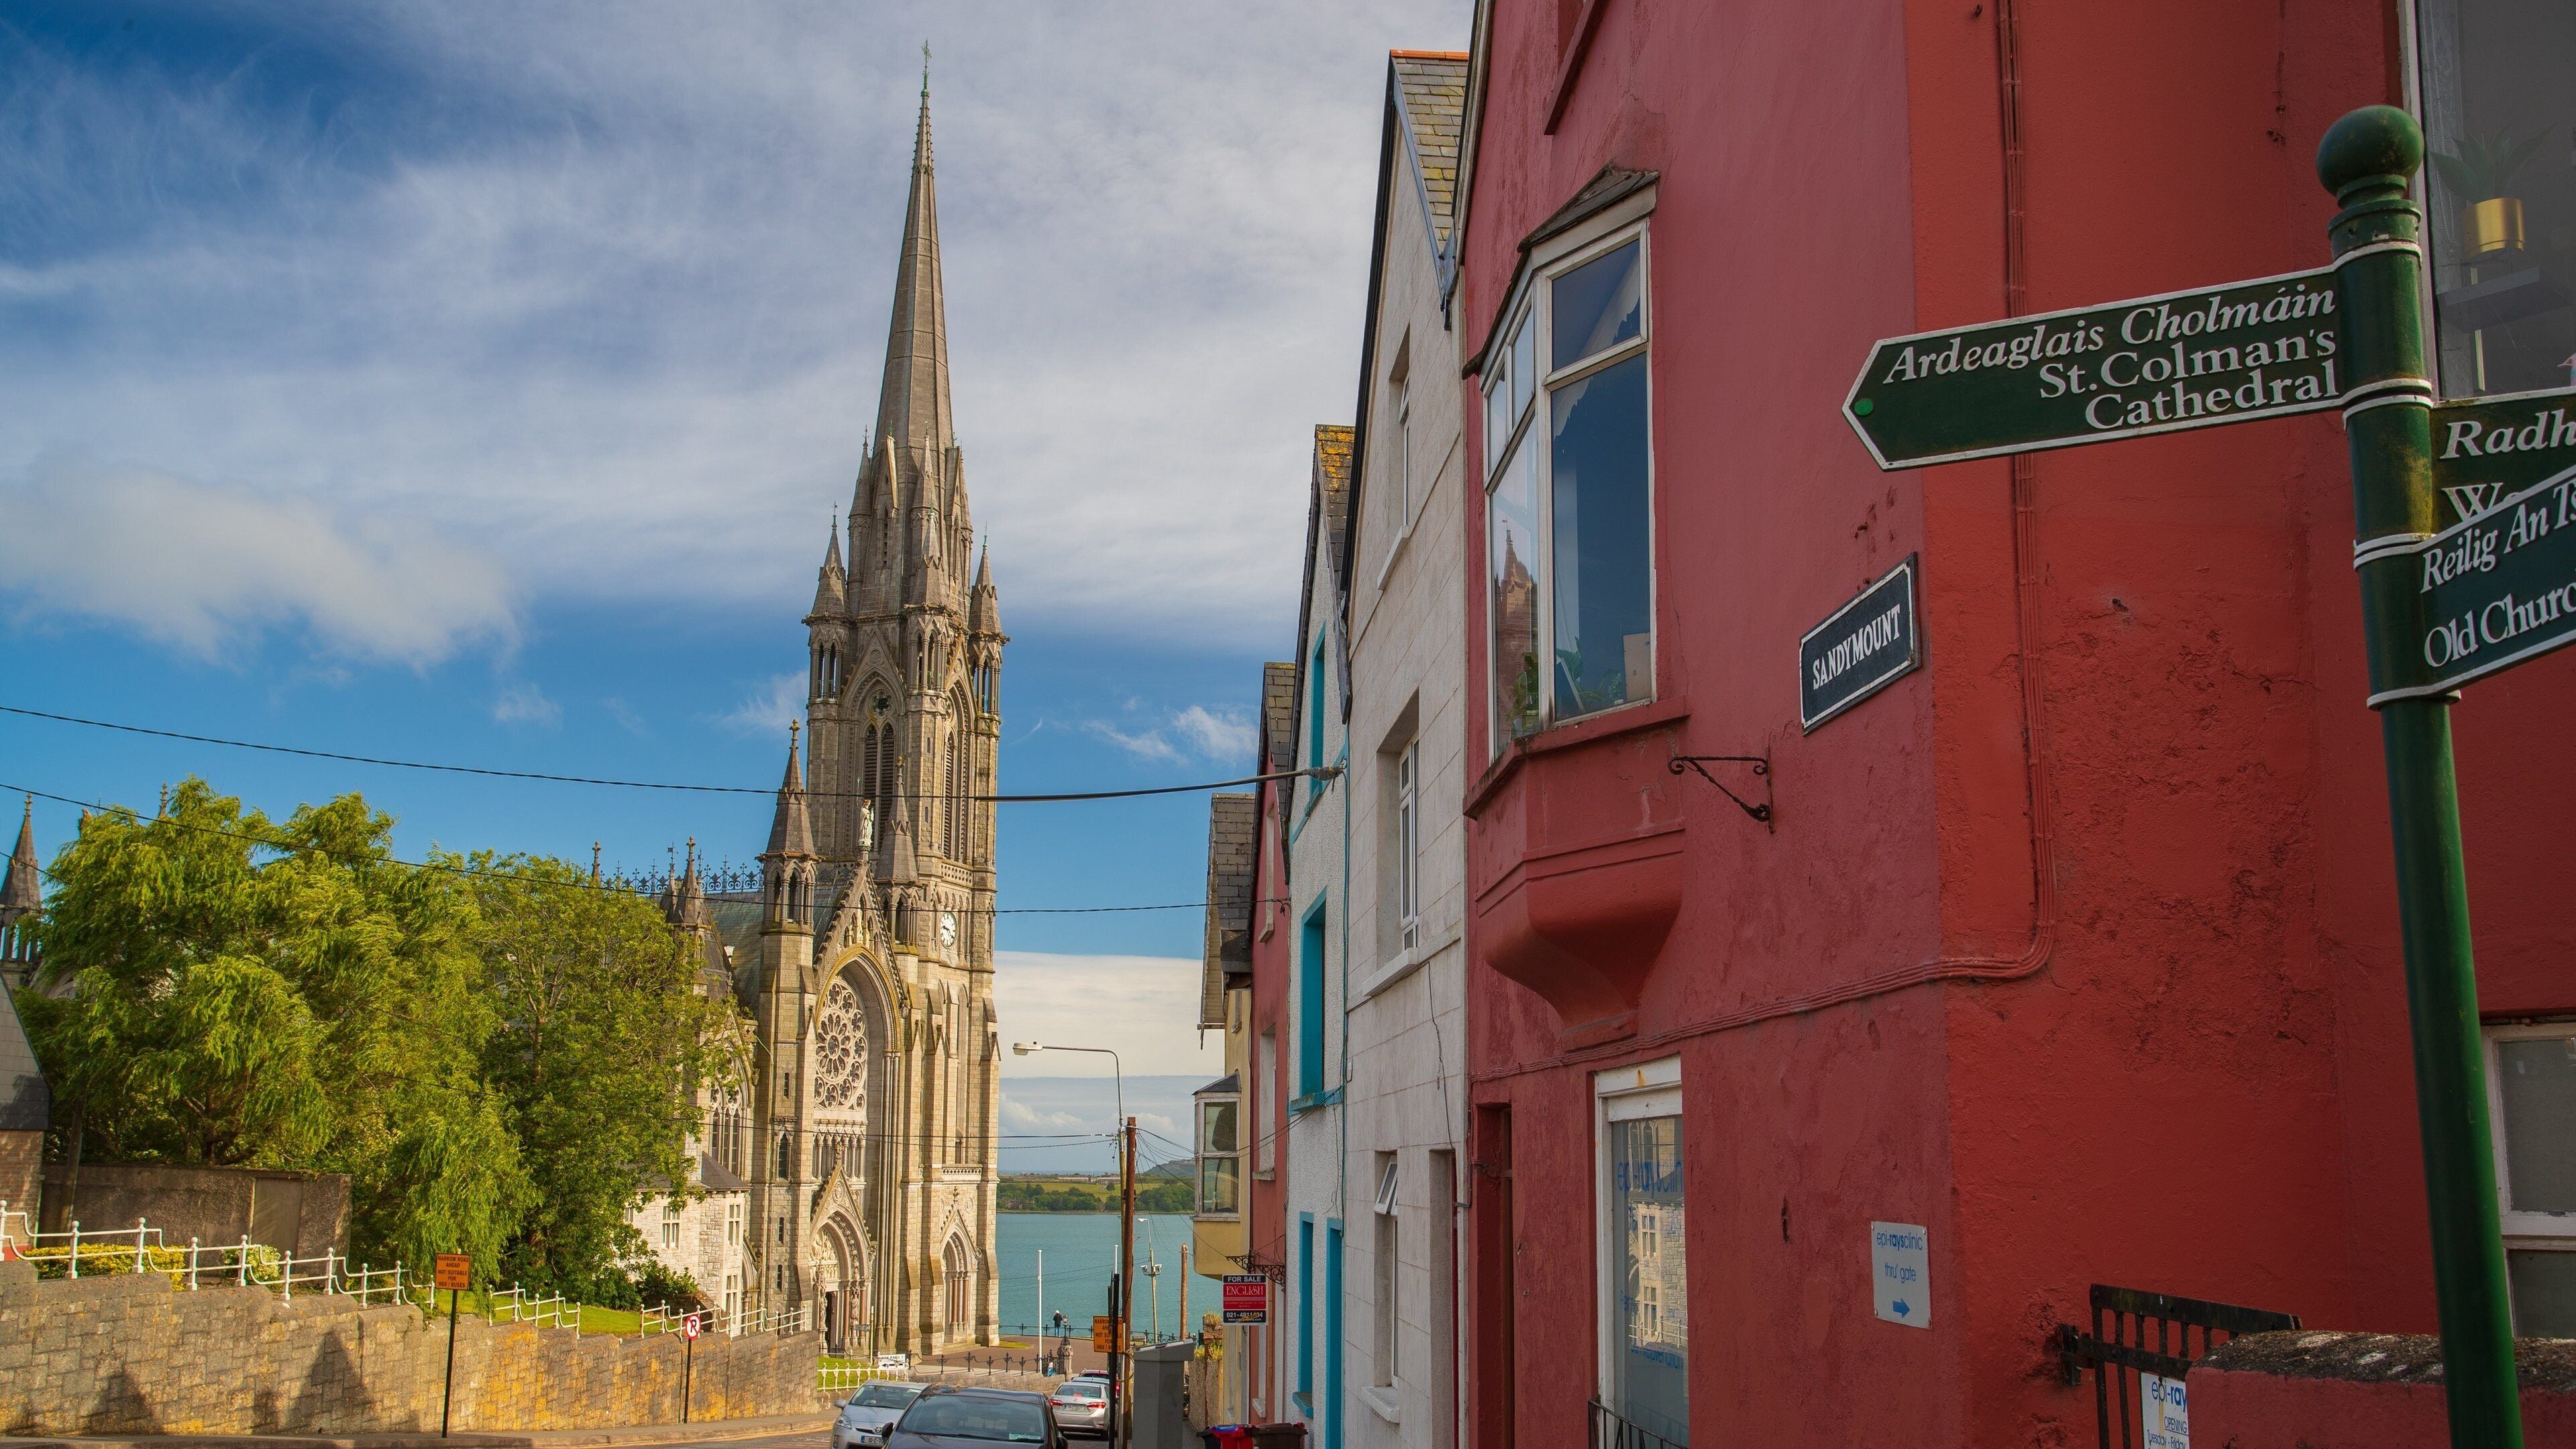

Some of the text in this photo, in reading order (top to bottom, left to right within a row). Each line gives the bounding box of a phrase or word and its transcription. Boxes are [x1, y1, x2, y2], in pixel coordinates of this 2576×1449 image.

[1882, 284, 2336, 384] Ardeaglais Cholmáin
[2085, 359, 2339, 429] Cathedral
[2439, 408, 2576, 460] Radh
[2440, 482, 2521, 523] W
[2420, 528, 2499, 594] Reilig
[2503, 503, 2548, 555] An
[1813, 603, 1900, 690] SANDYMOUNT
[2424, 582, 2576, 667] Old Churc
[1876, 1230, 1923, 1251] epi-raysclinic
[1226, 1285, 1263, 1295] ENGLISH
[1884, 1262, 1917, 1283] thru' gate
[2147, 1429, 2167, 1448] Tuesday
[2170, 1436, 2186, 1449] Friday
[2164, 1415, 2187, 1434] OPENING
